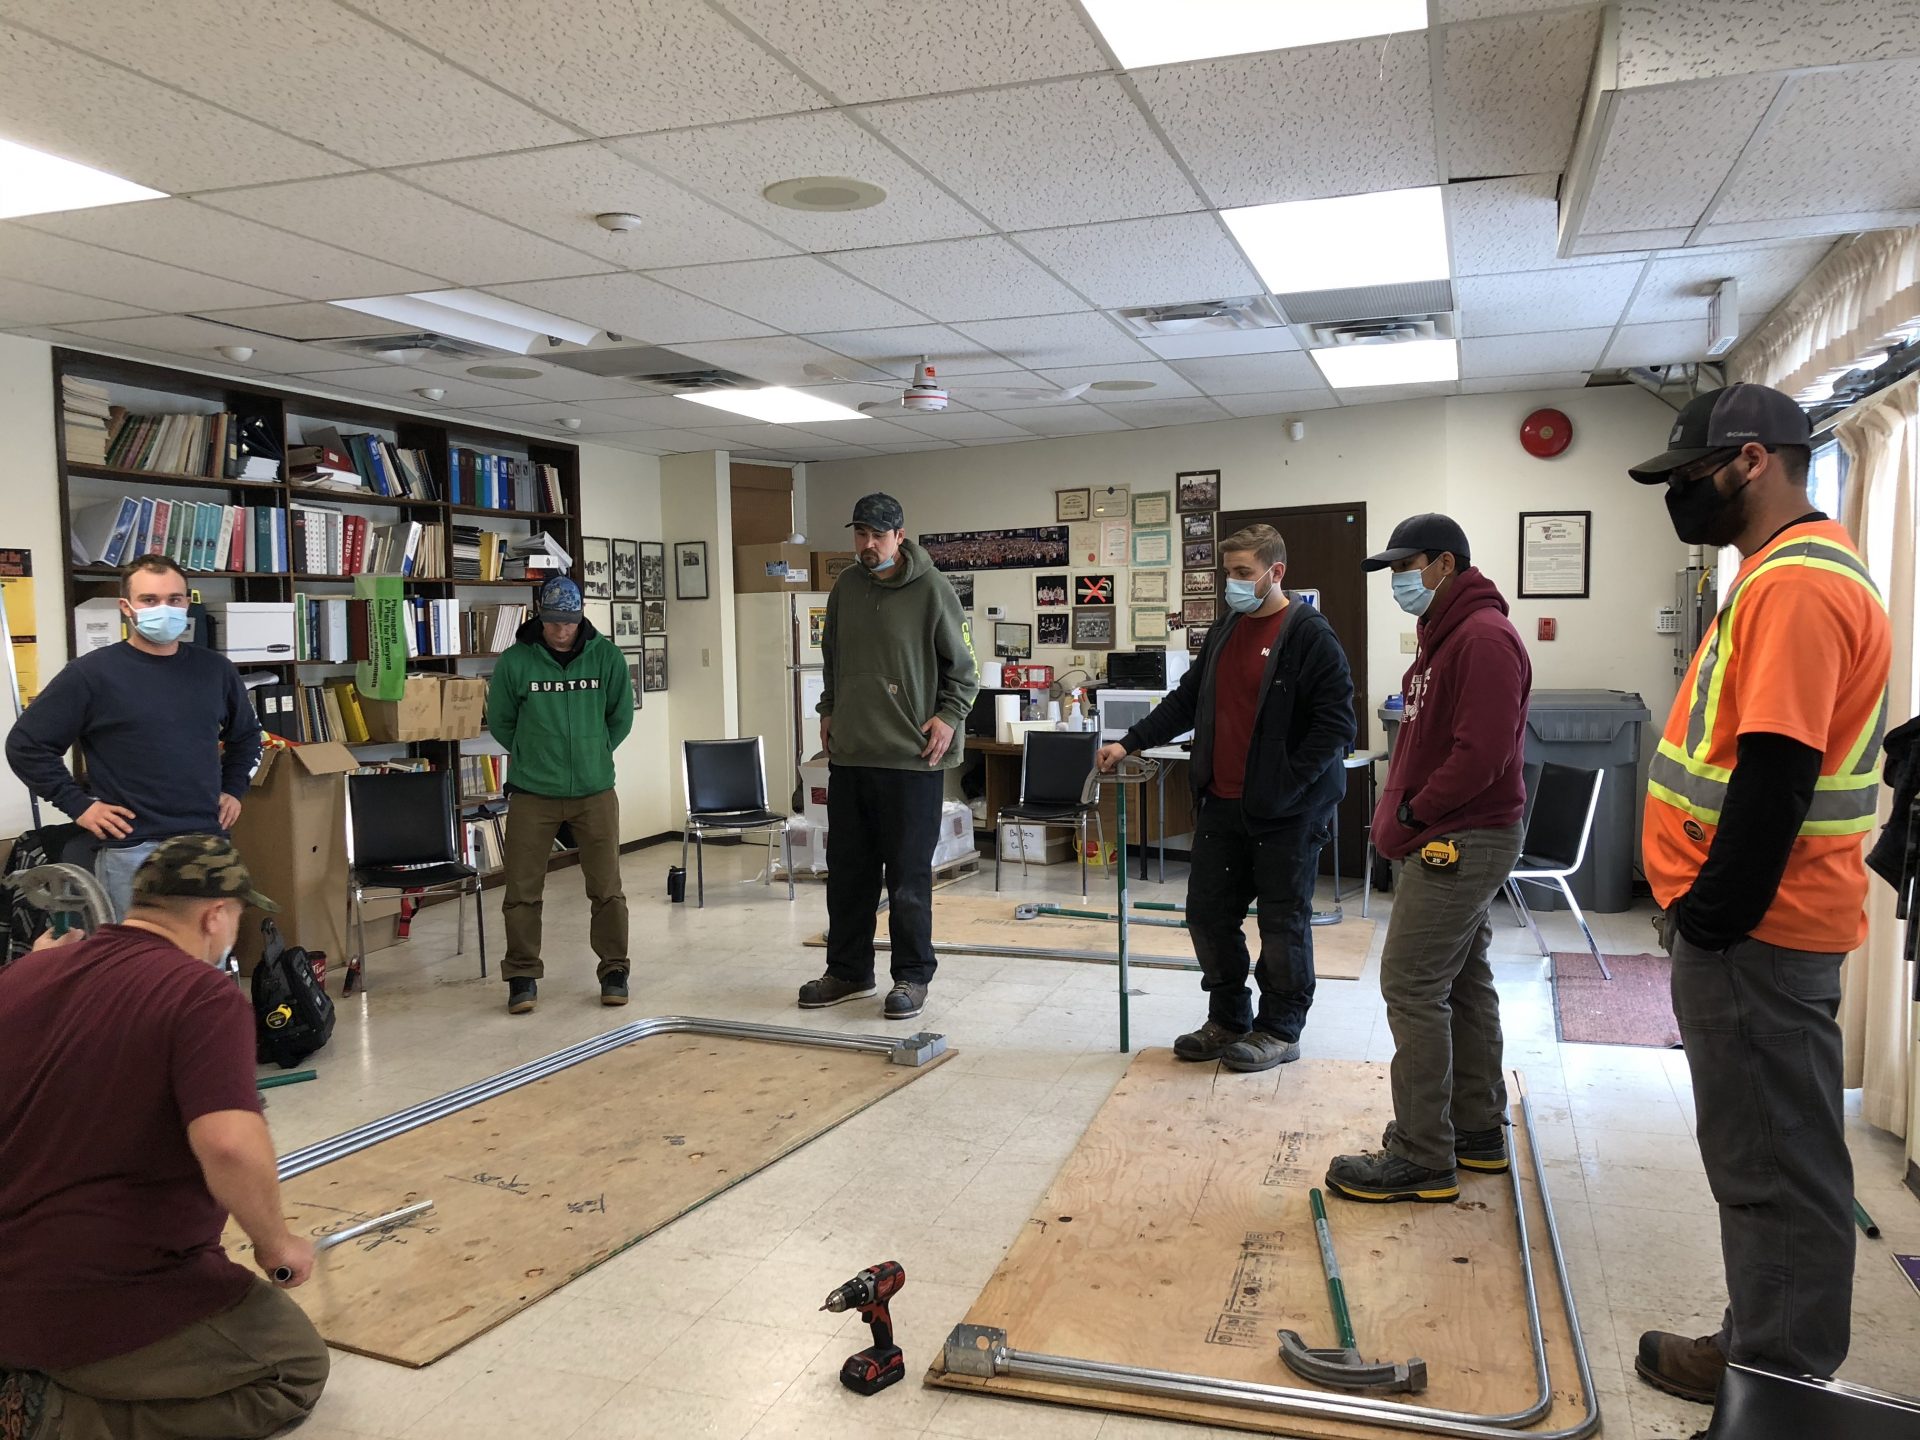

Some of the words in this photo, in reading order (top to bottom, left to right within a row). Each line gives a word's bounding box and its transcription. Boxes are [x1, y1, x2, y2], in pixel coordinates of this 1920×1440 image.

[390, 598, 398, 644] Pharmacare
[384, 637, 392, 671] Everyone
[530, 679, 600, 692] BURTON
